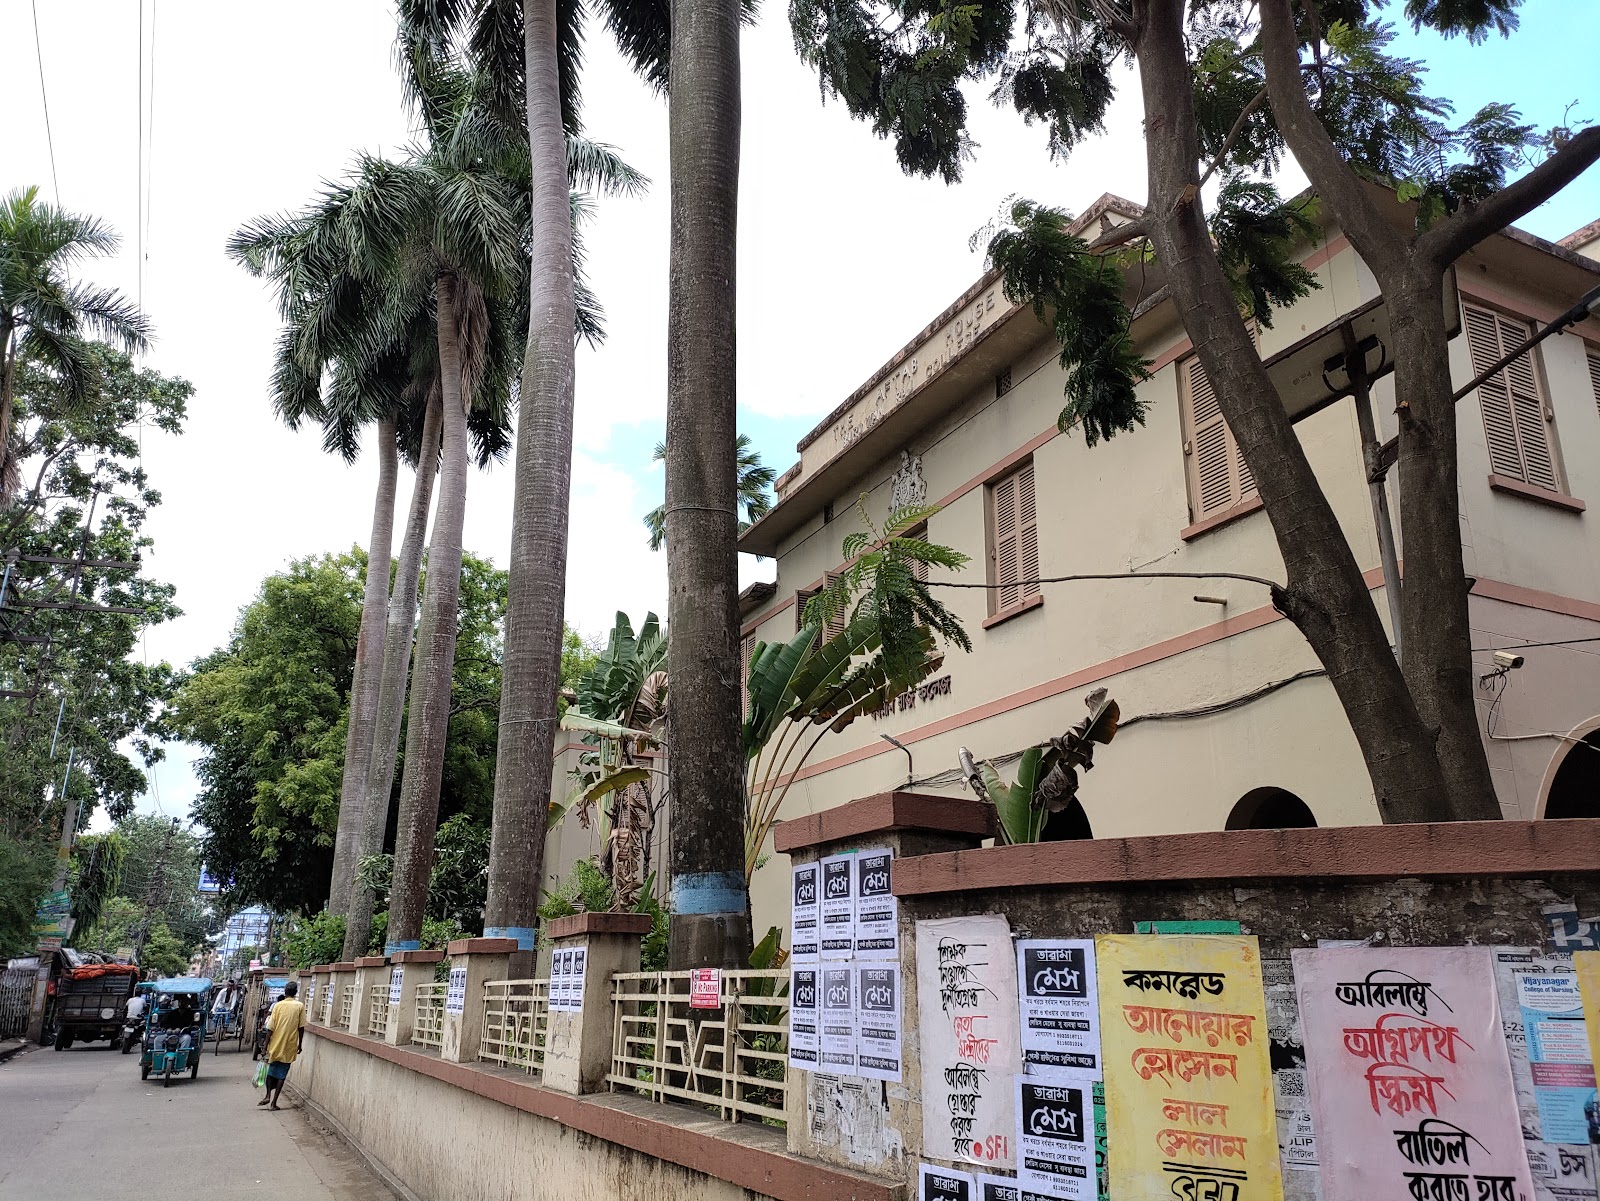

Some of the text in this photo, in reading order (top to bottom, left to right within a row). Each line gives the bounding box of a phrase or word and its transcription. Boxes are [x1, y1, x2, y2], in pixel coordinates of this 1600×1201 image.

[946, 289, 996, 348] HOUSE
[918, 674, 952, 703] কলেজ
[827, 875, 848, 898] মেস
[863, 871, 888, 895] মেস
[938, 937, 987, 962] শিক্ষক
[1034, 967, 1080, 995] মেস
[1121, 970, 1226, 1000] কমরেড
[1335, 969, 1453, 1016] অবিলম্বে
[1522, 976, 1570, 986] Vijayanagar
[1551, 986, 1574, 994] Nursing
[796, 985, 814, 1007] মেস
[826, 984, 849, 1008] মেস
[865, 984, 892, 1009] মেস
[954, 1015, 988, 1038] নেতা
[1122, 1004, 1256, 1047] আনোয়ার
[1342, 1013, 1475, 1064] অগ্নিপথ
[944, 1062, 989, 1094] অবিলম্বে
[1131, 1047, 1239, 1089] হোসেন
[1364, 1062, 1456, 1118] স্কিম
[950, 1117, 978, 1138] করতে
[1030, 1105, 1078, 1136] মেস
[1162, 1098, 1229, 1129] লাল
[952, 1134, 1008, 1160] হবে SFI
[1156, 1128, 1248, 1161] সেলাম
[1393, 1118, 1491, 1167] বাতিল
